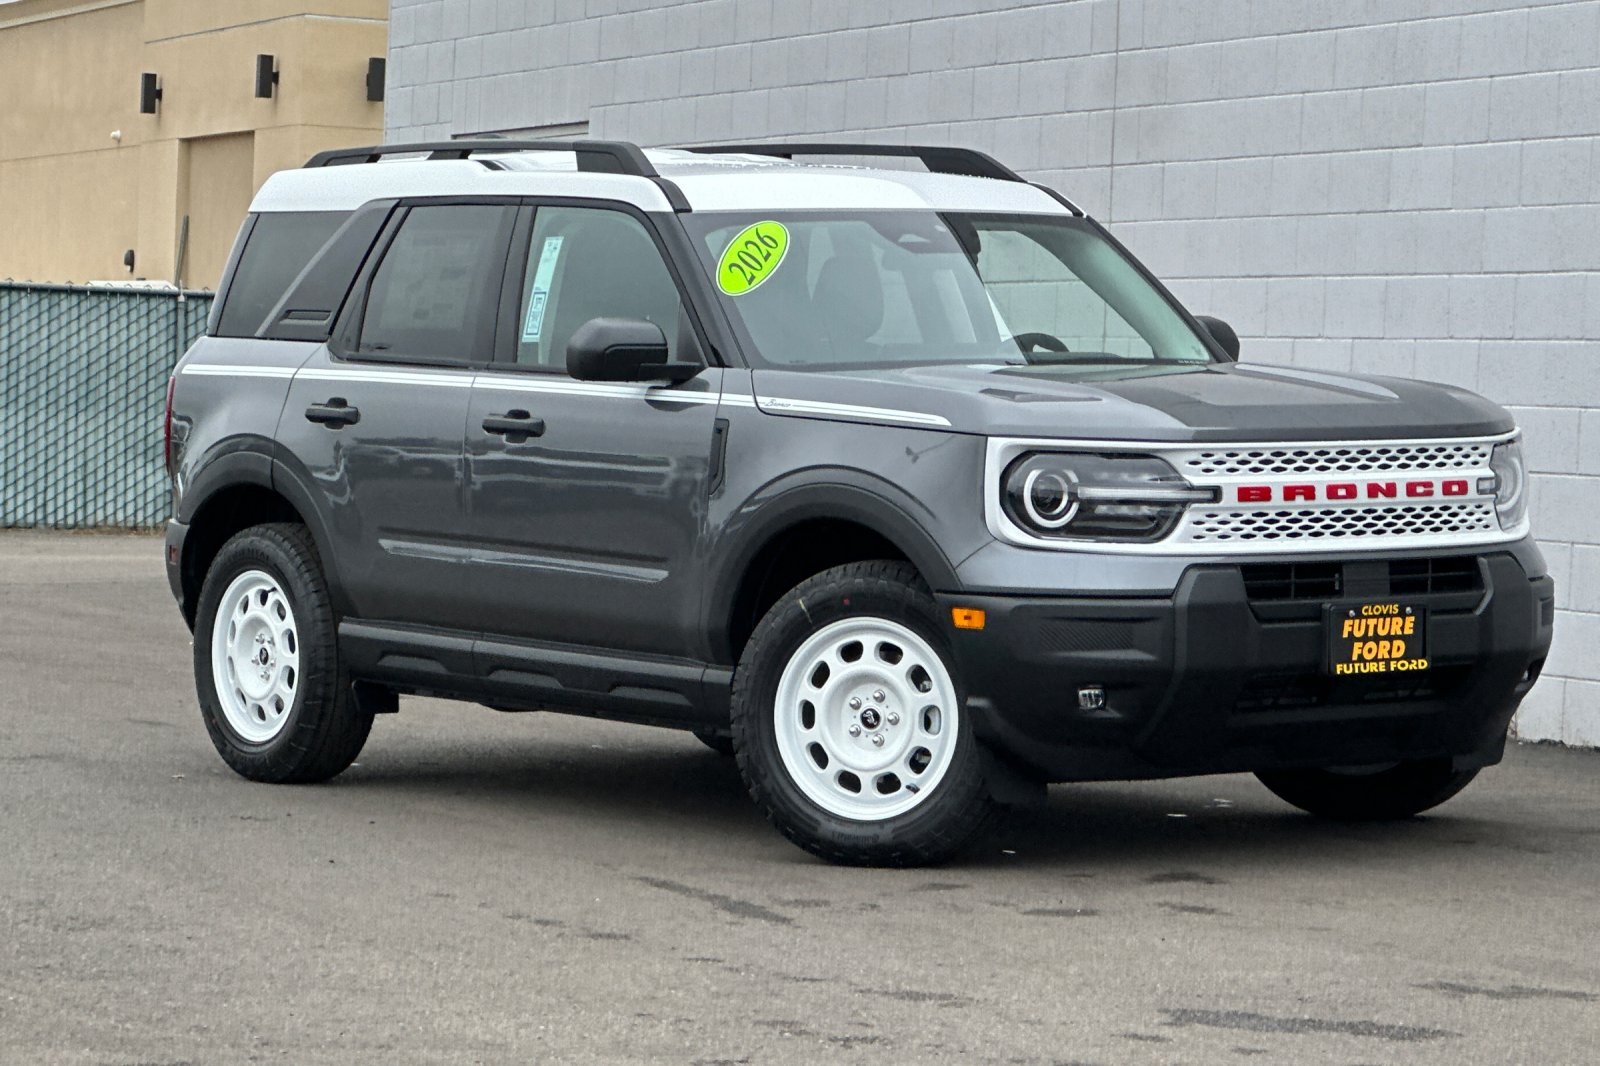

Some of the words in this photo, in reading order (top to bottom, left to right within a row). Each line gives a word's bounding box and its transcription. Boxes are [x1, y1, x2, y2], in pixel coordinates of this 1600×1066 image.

[728, 227, 779, 286] 2026
[1237, 480, 1468, 503] BRONCO
[1361, 604, 1399, 616] CLOVIS
[1342, 616, 1416, 638] FUTURE
[1351, 639, 1406, 661] FORD
[1336, 661, 1387, 675] FUTURE
[1390, 658, 1428, 672] FORD
